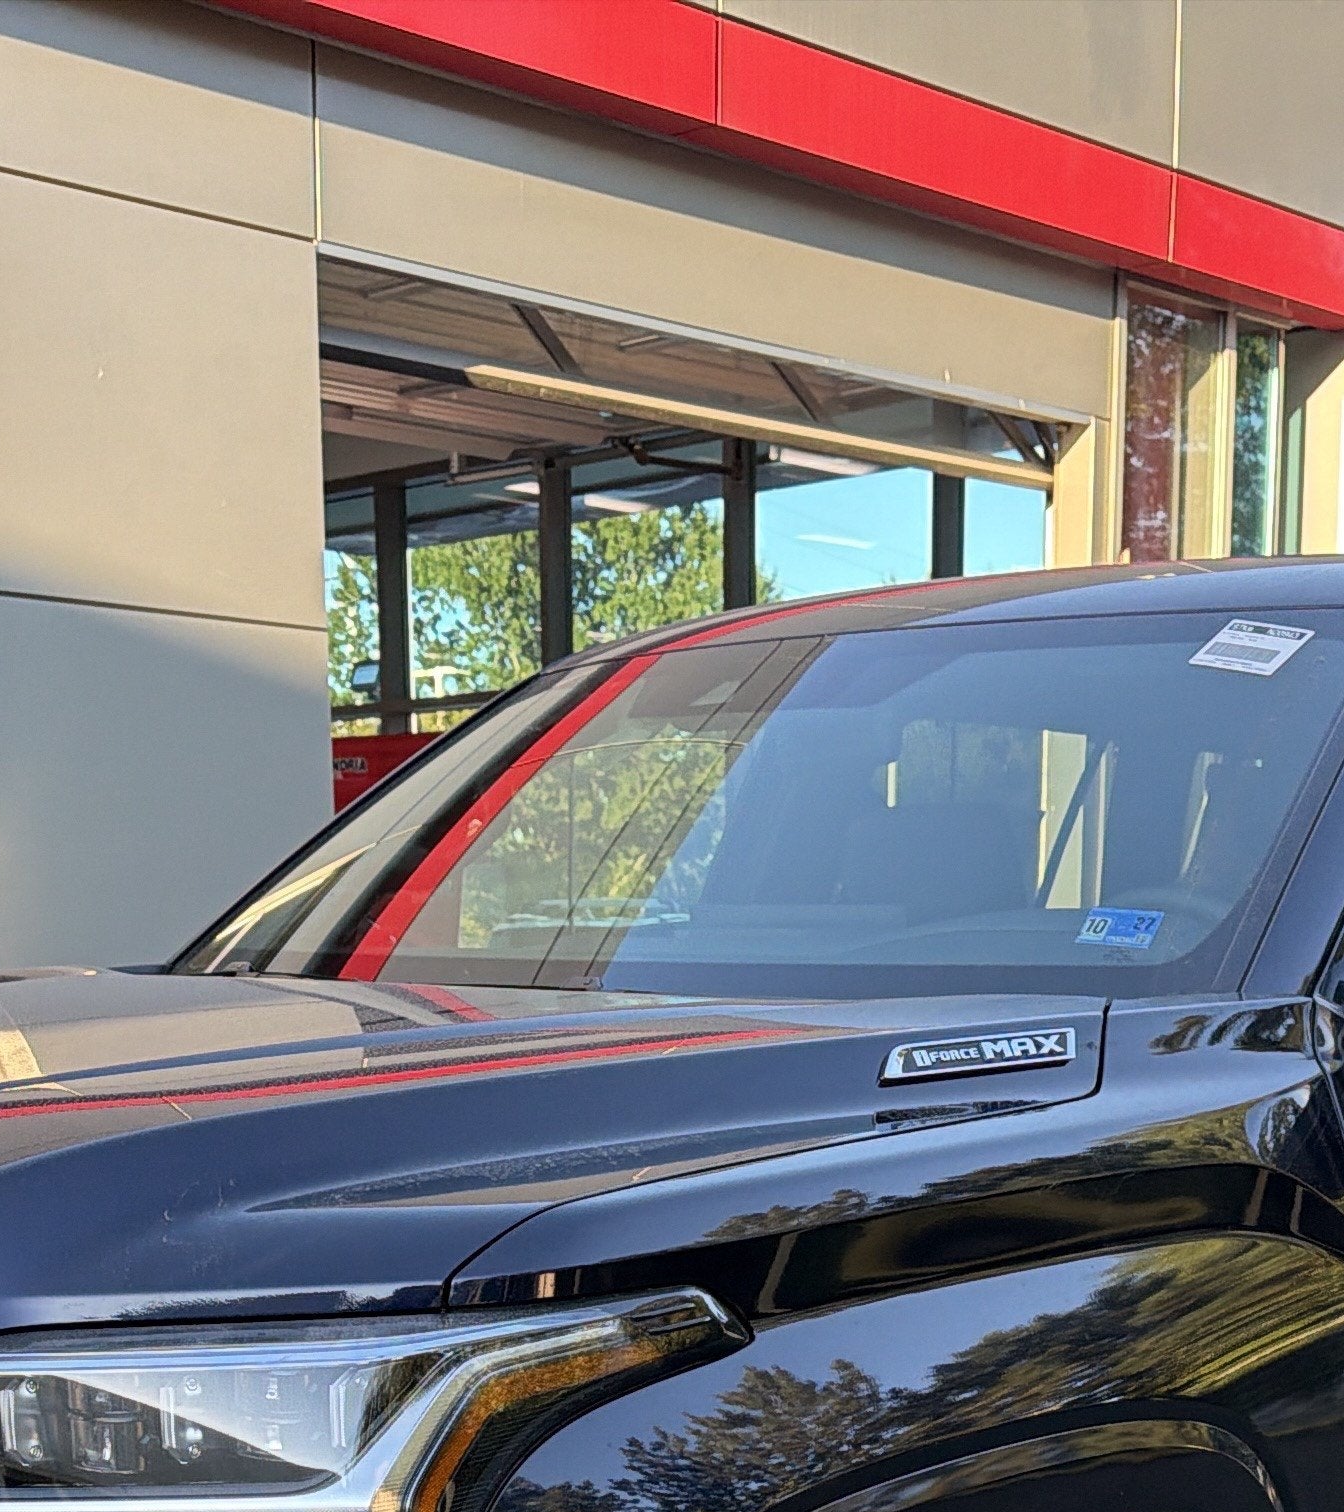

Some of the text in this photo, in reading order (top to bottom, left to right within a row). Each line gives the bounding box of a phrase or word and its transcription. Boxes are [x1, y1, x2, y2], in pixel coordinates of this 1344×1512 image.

[1086, 918, 1109, 934] 10
[1133, 917, 1157, 931] 27
[981, 1034, 1065, 1061] MAX
